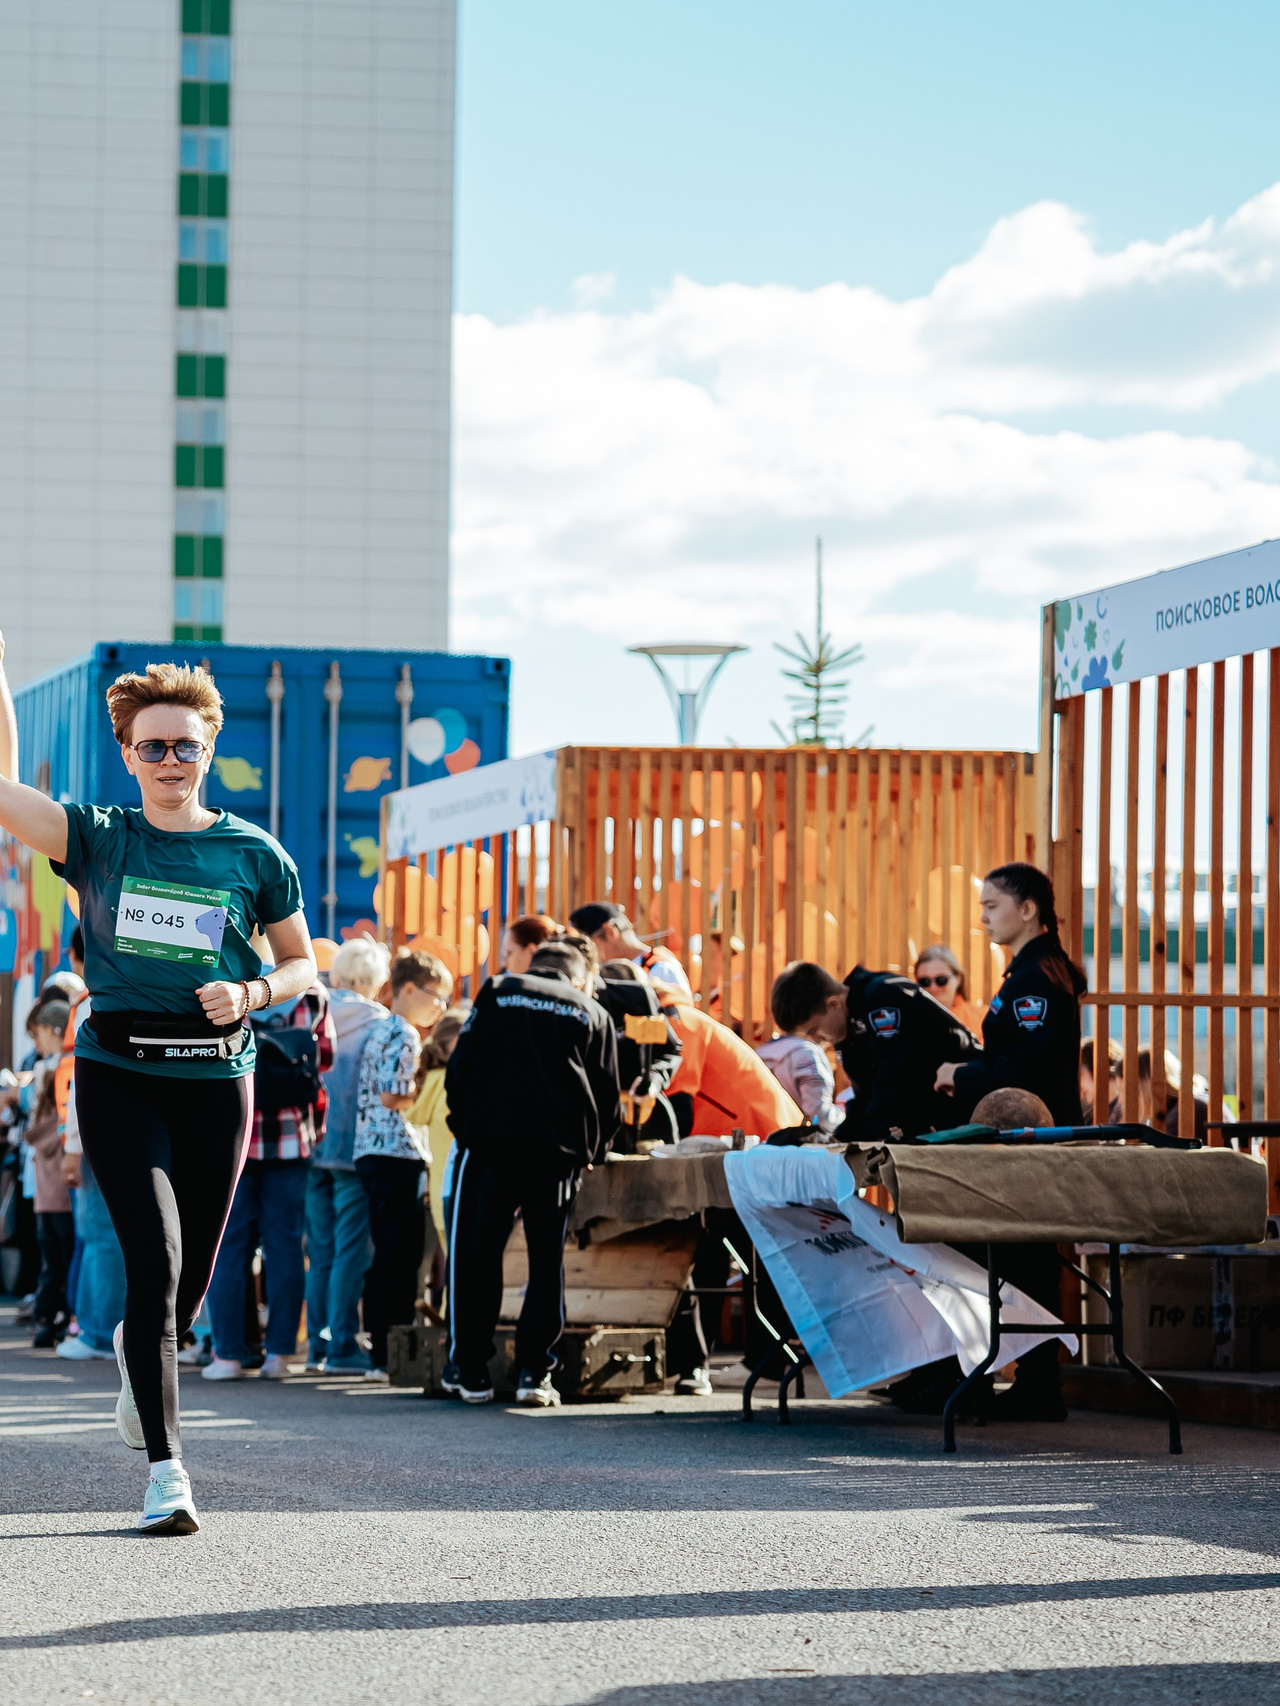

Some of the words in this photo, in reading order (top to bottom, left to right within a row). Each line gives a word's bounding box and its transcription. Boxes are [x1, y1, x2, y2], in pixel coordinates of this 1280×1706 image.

[1156, 589, 1240, 632] ПОИСКОВОЕ
[125, 907, 145, 923] №
[151, 912, 185, 929] 045
[165, 1047, 217, 1057] SILAPRO
